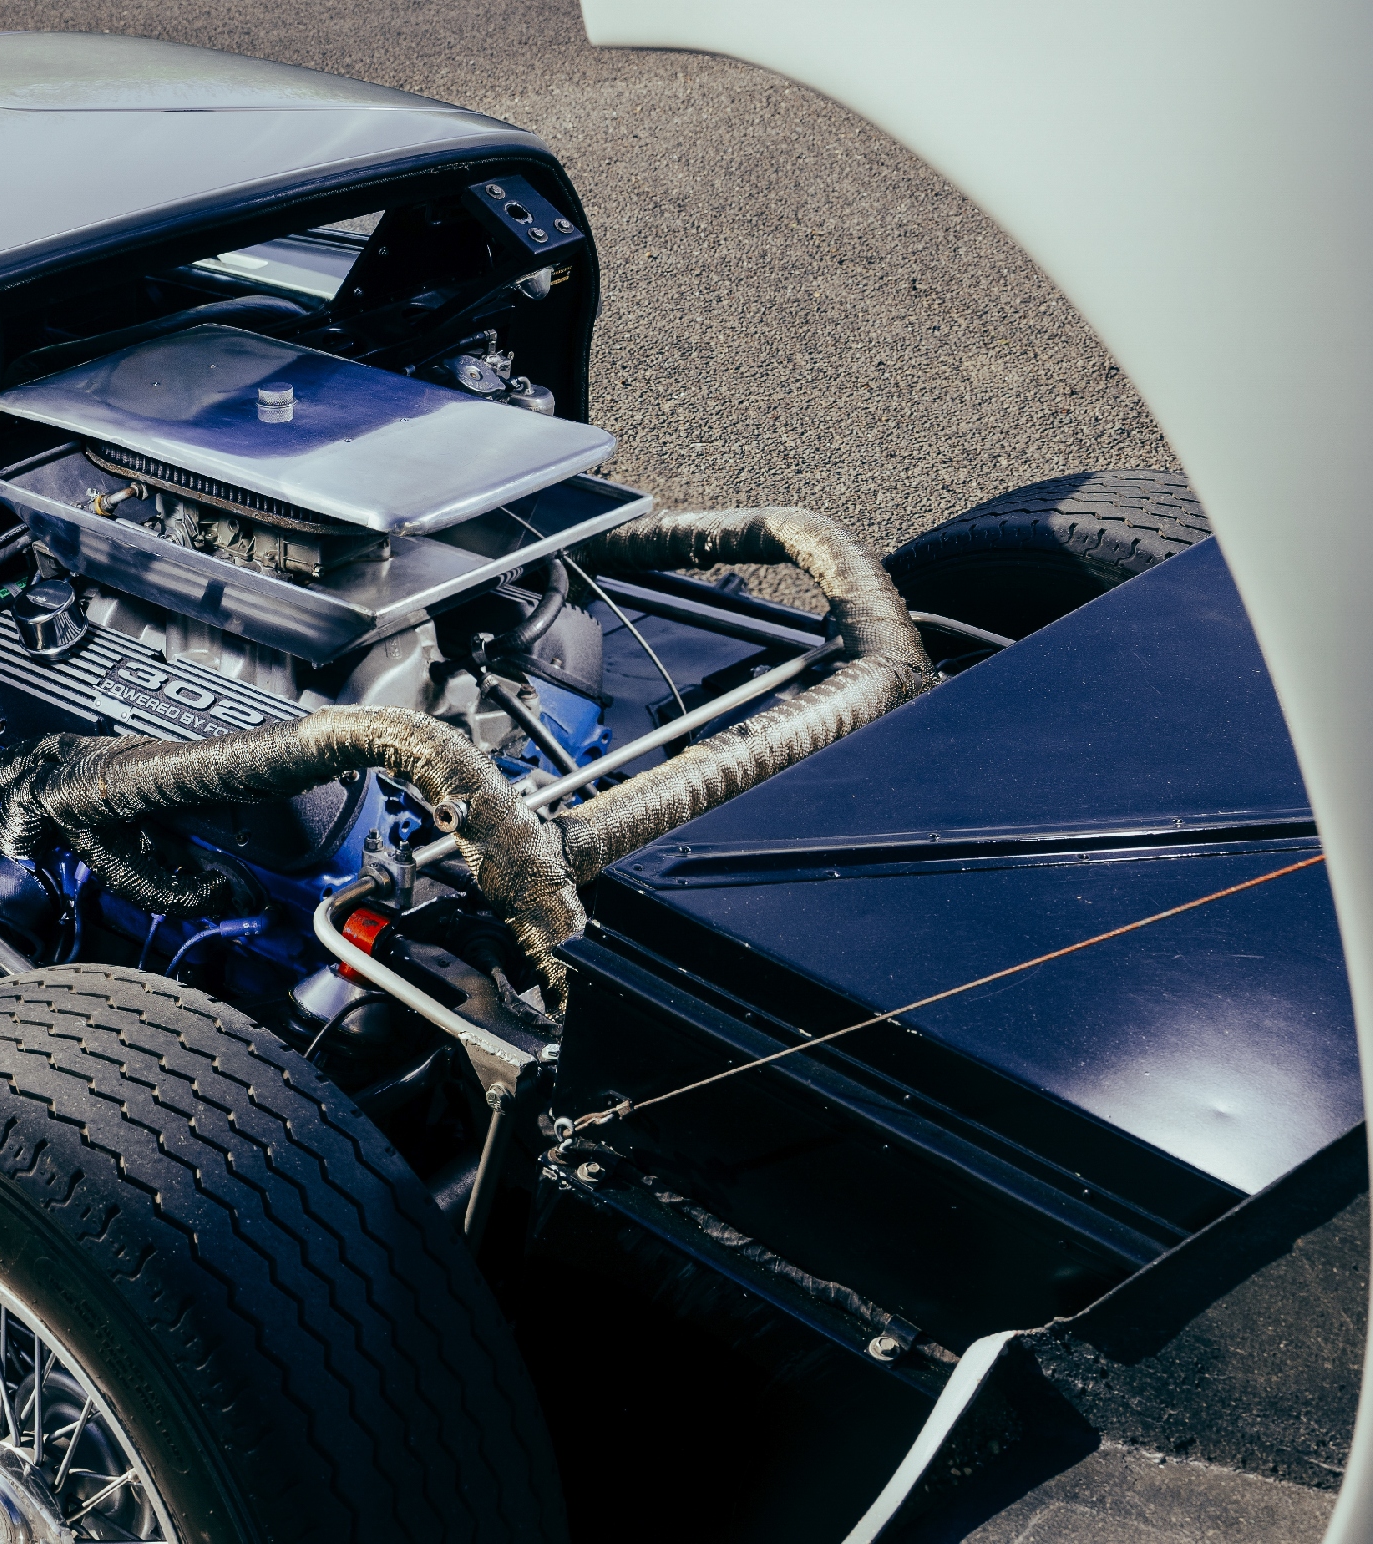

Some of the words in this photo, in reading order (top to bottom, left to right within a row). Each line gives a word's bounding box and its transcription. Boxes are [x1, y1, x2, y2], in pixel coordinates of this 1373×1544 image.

[100, 679, 181, 720] POWERED
[180, 712, 205, 729] BY
[203, 723, 233, 737] FO
[117, 661, 265, 731] 302
